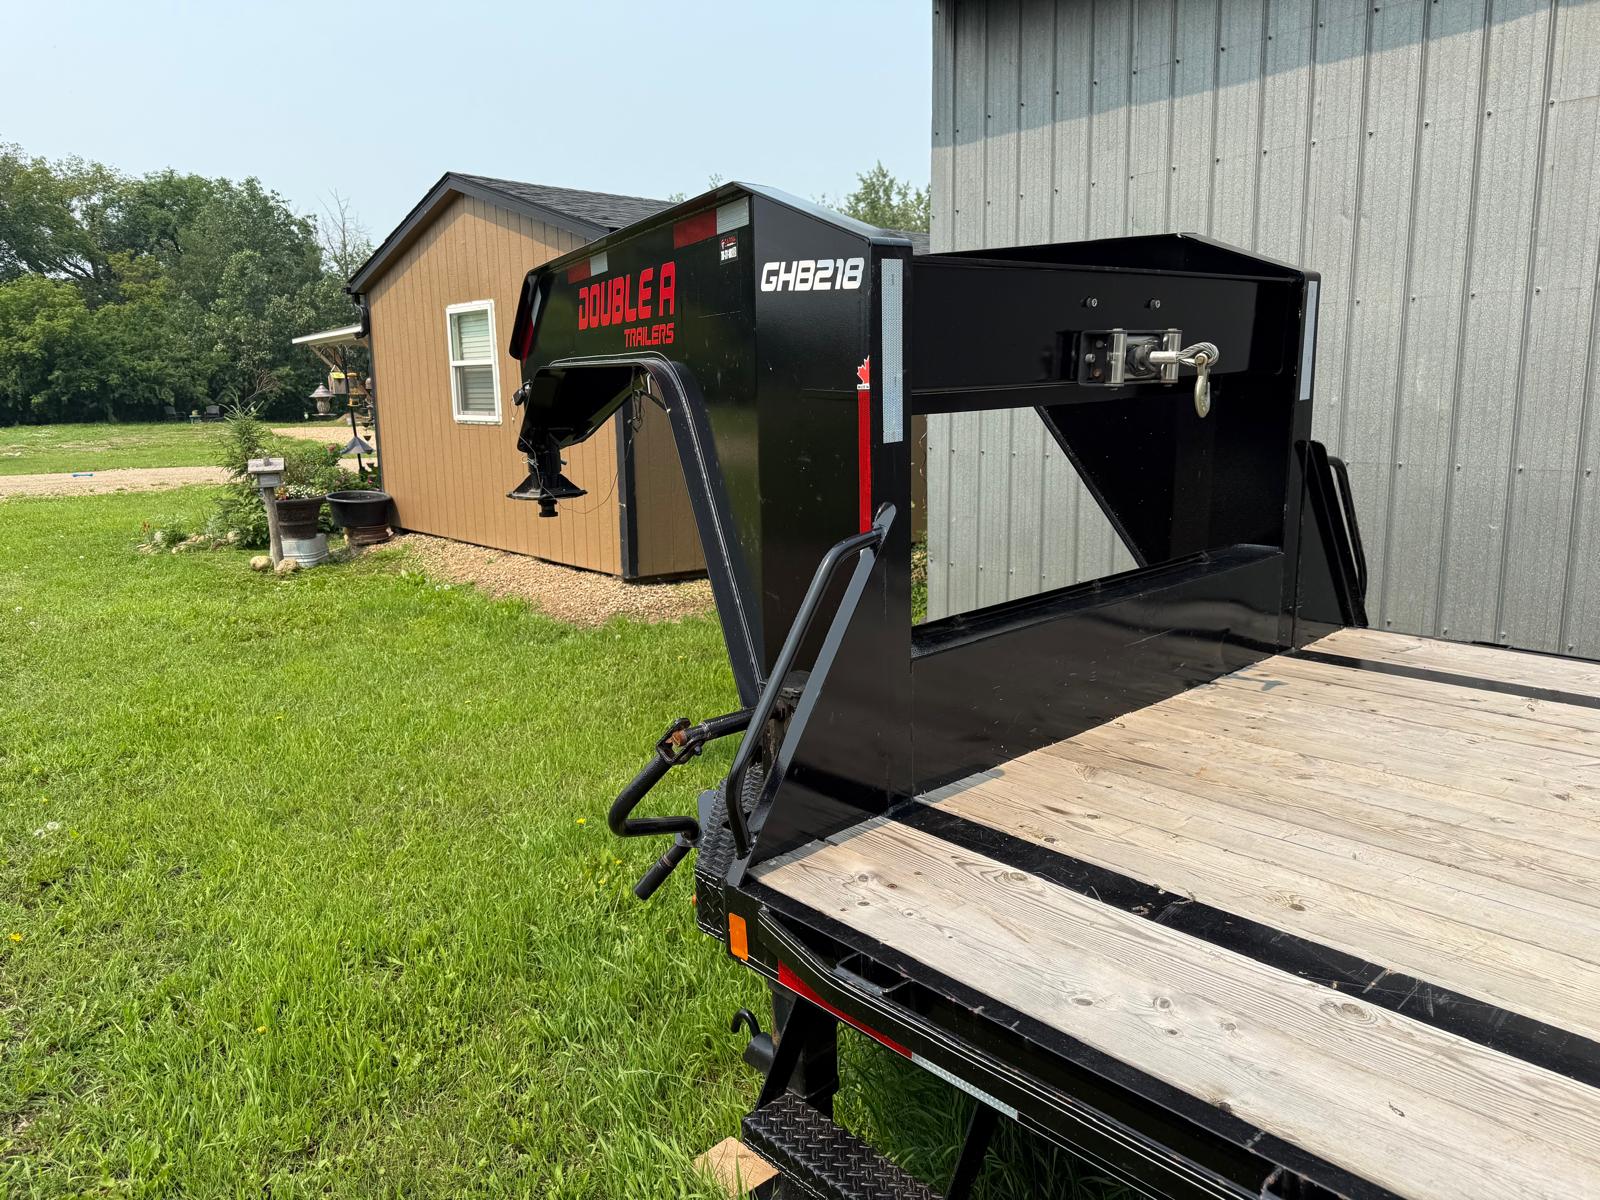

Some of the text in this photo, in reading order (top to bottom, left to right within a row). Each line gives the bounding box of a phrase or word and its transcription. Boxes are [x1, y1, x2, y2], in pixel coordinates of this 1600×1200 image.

[760, 257, 865, 292] GHB218
[578, 261, 676, 331] DOUBLE A
[624, 322, 675, 348] TRAILERS
